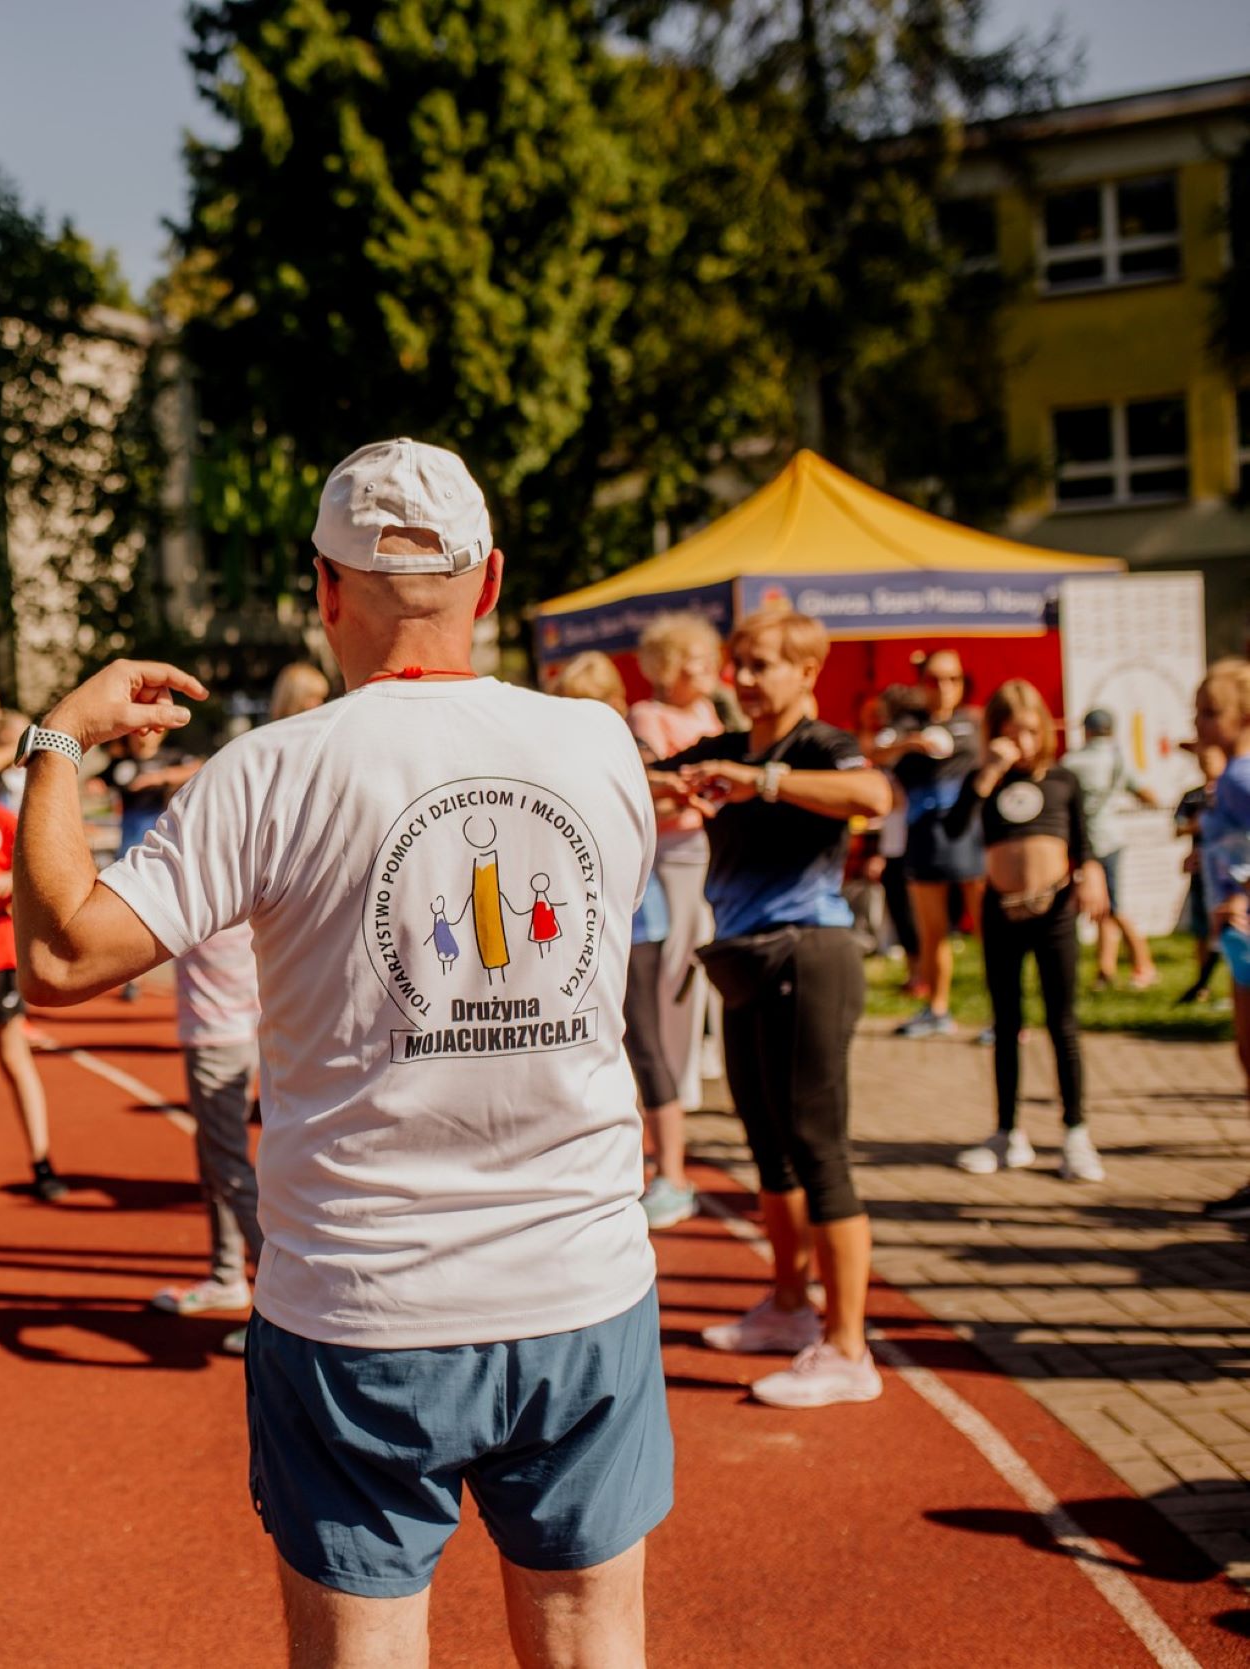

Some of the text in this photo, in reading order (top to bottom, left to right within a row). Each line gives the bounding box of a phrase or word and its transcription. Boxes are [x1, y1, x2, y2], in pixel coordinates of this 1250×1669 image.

[375, 790, 597, 1017] TOWARZYSTWO POMOCY DZIECIOM I MŁODZIEŻY Z CUKRZYCĄ
[451, 995, 540, 1023] Drużyna
[404, 1016, 589, 1059] MOJACUKRZYCA.PL
